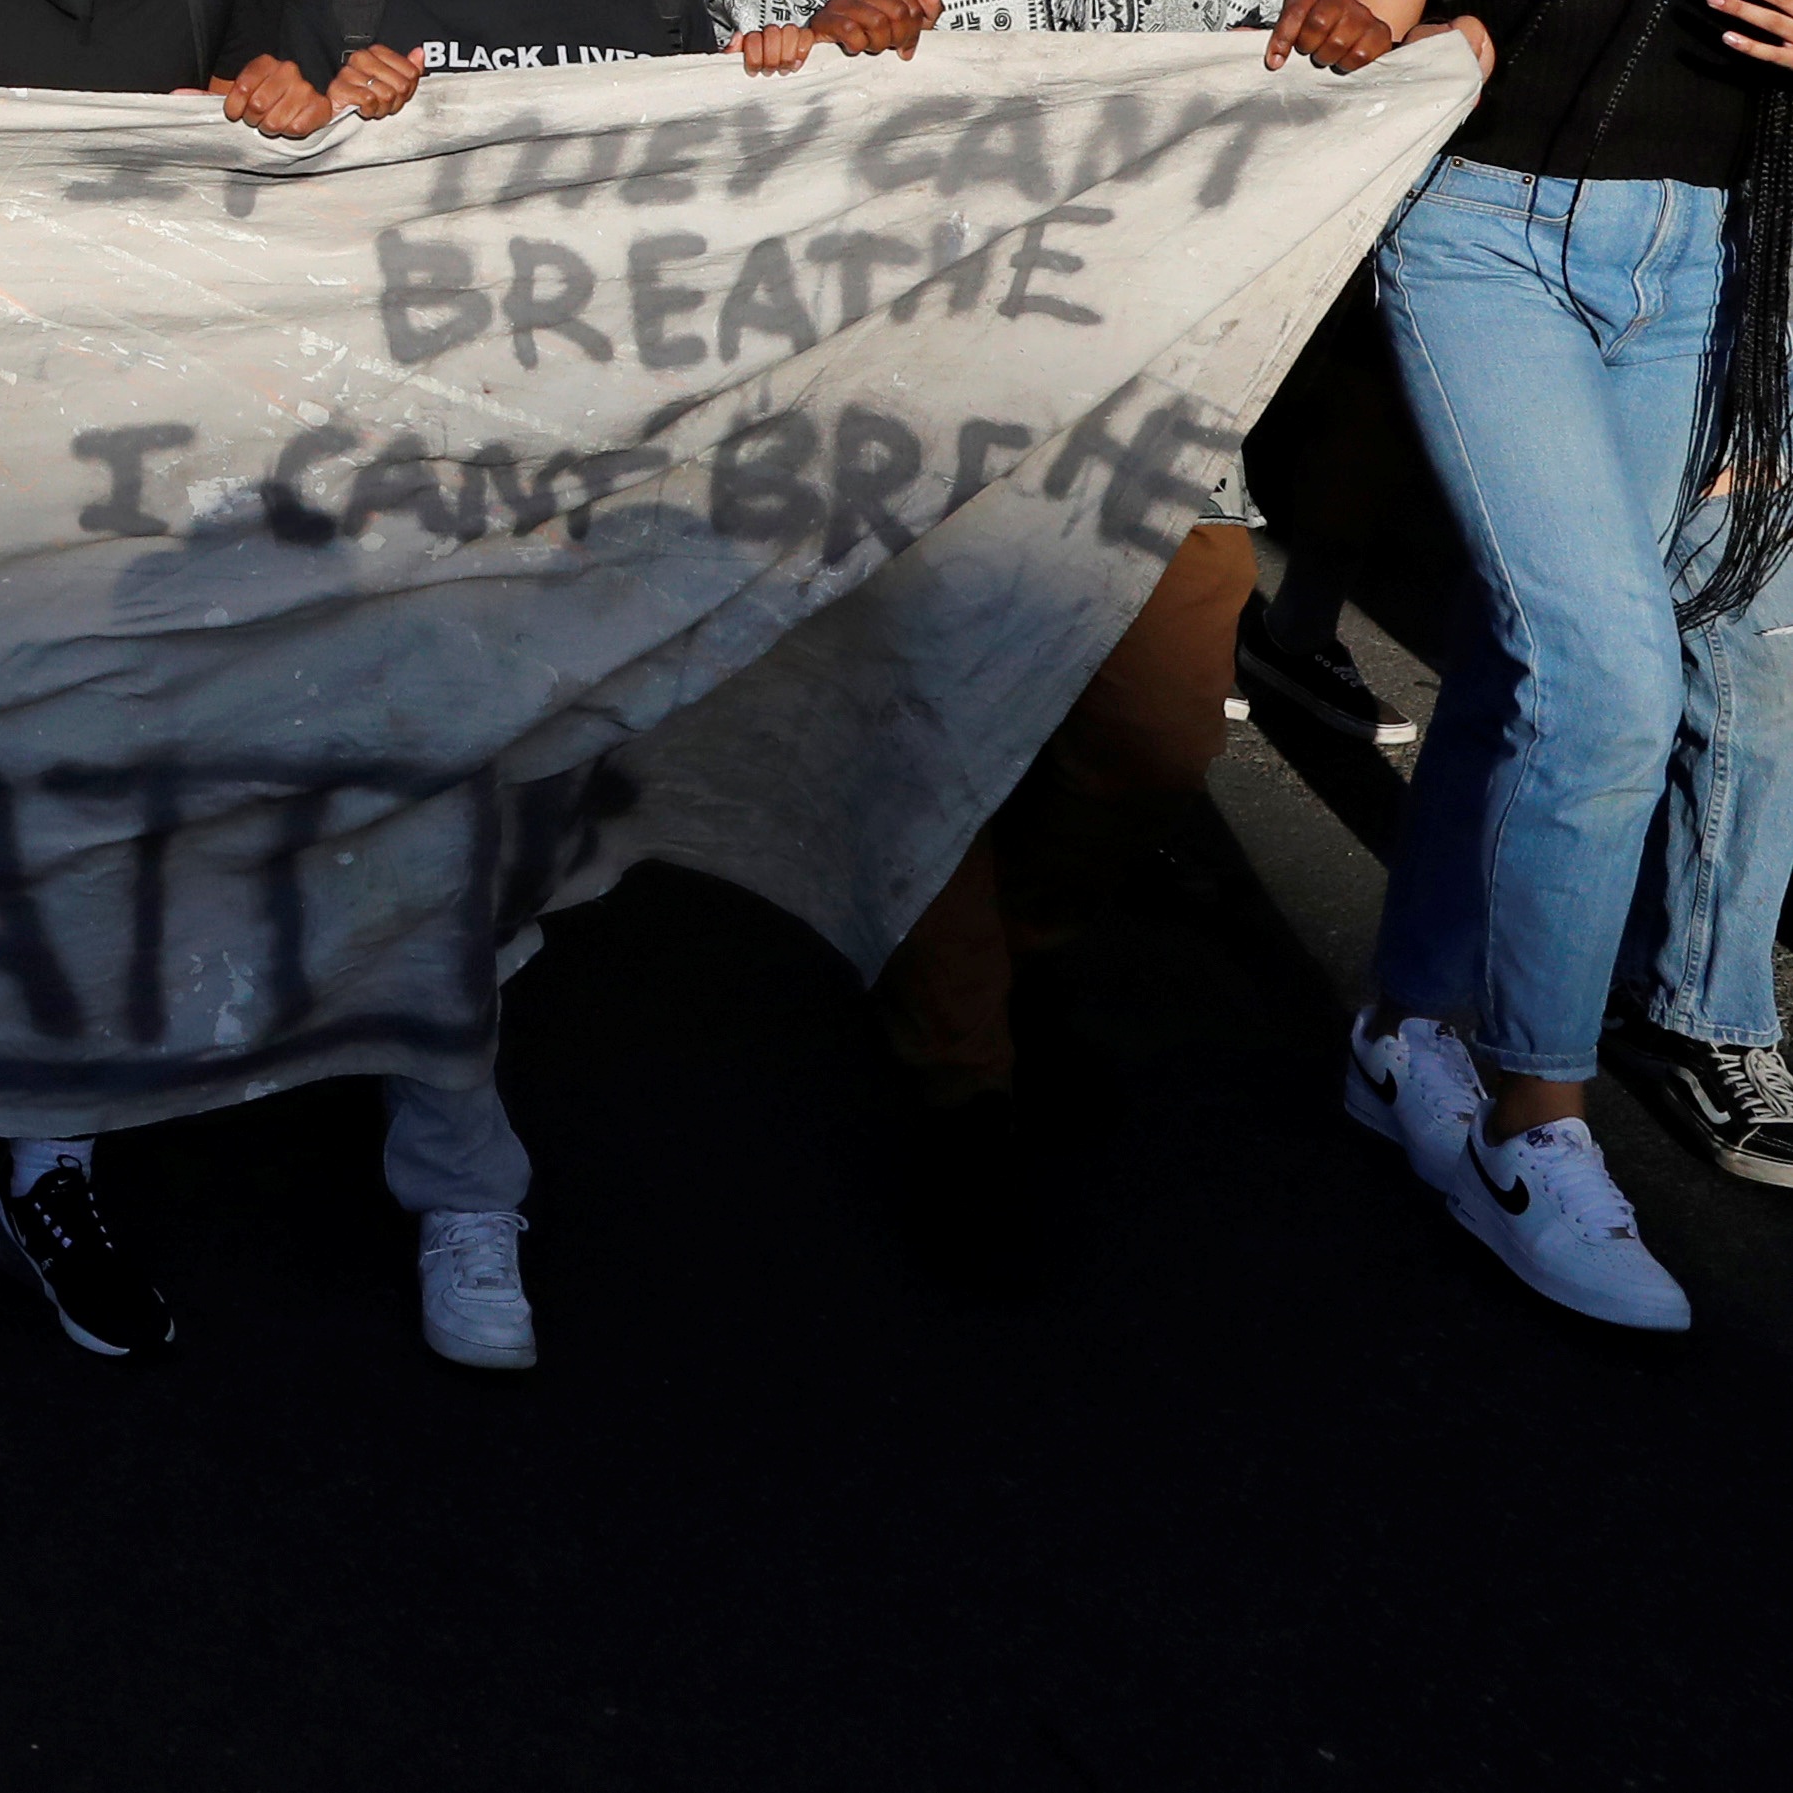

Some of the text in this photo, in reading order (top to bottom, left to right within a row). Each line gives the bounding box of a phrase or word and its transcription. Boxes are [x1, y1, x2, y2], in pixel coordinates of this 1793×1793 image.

[423, 41, 655, 70] BLACK LIVE
[375, 206, 1117, 371] BREATHE
[65, 422, 197, 537] I
